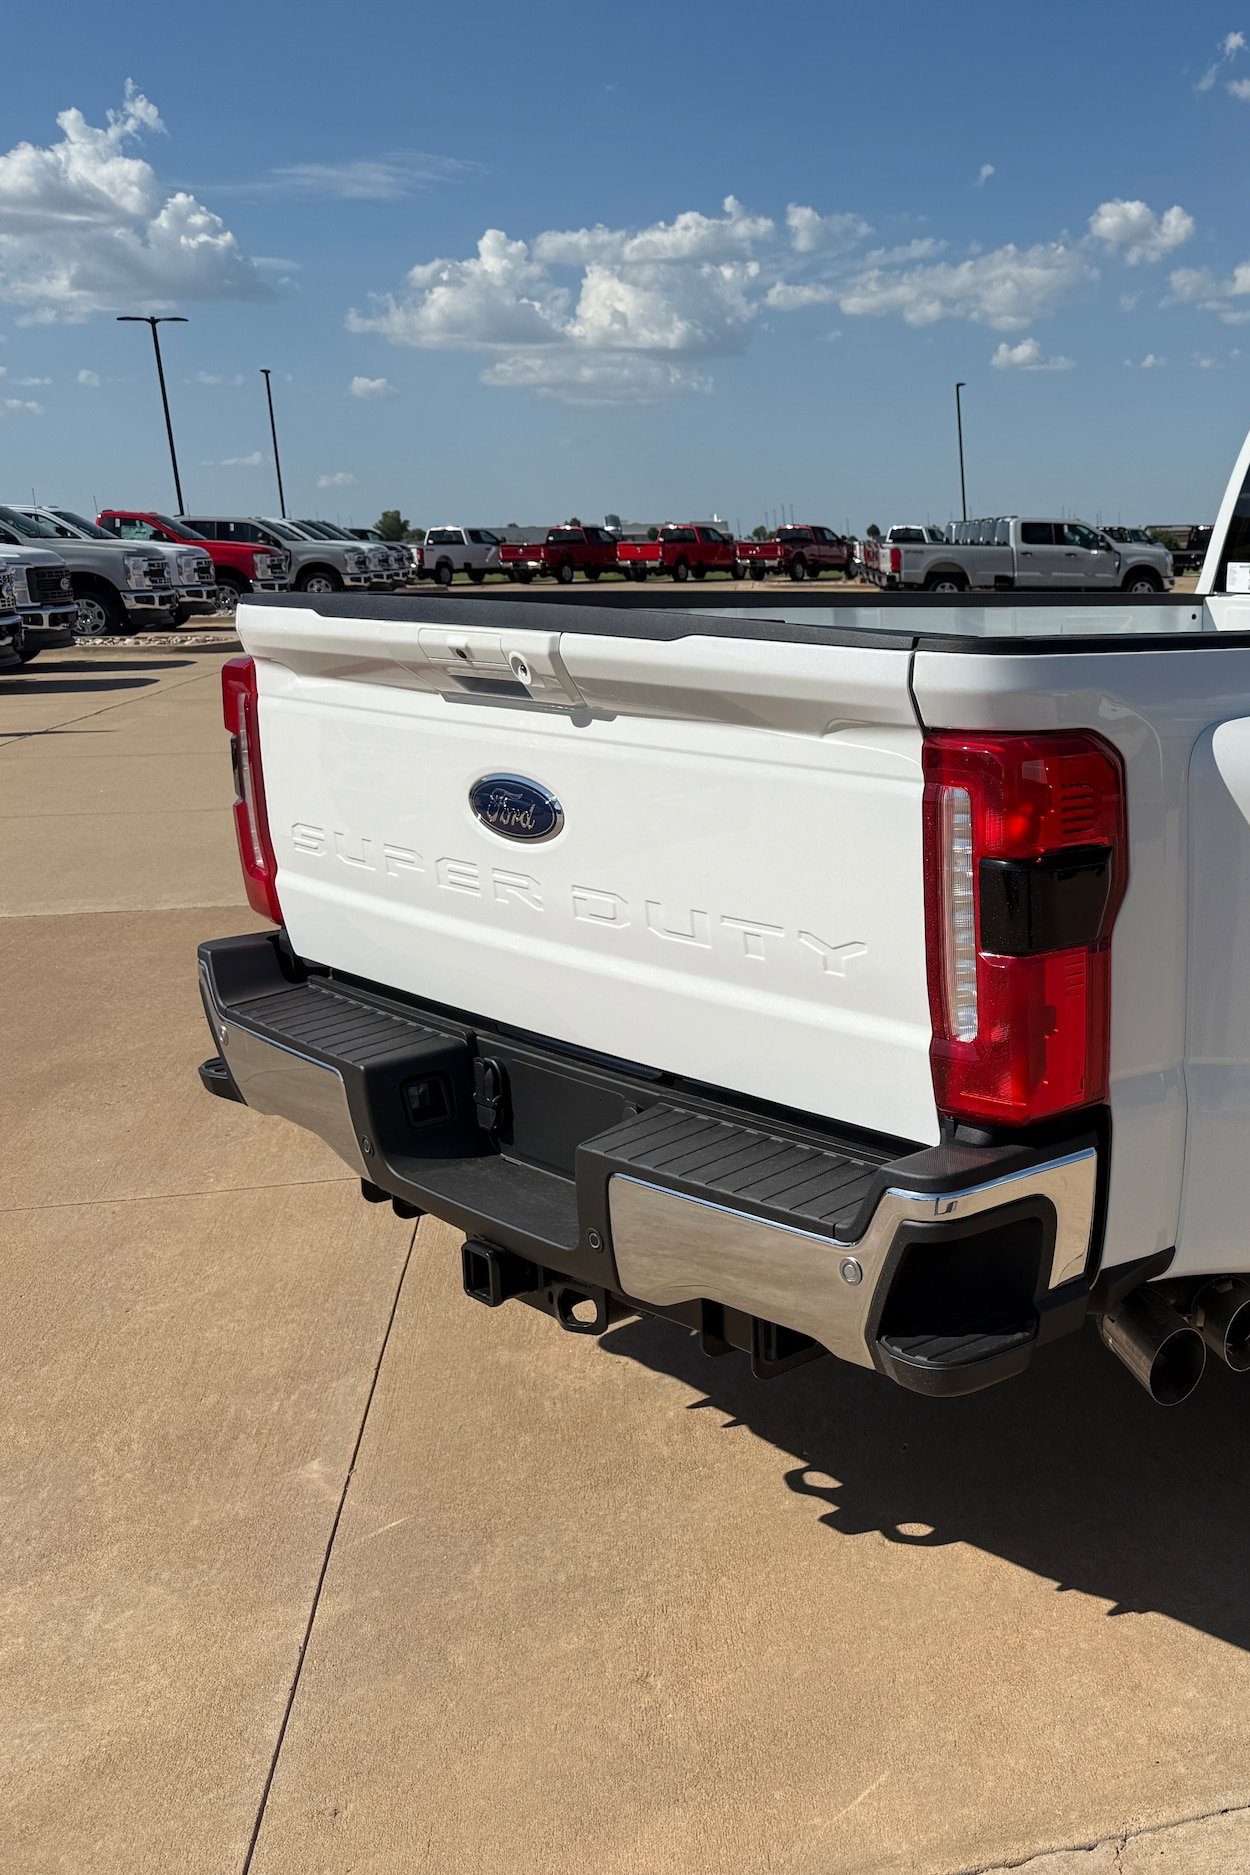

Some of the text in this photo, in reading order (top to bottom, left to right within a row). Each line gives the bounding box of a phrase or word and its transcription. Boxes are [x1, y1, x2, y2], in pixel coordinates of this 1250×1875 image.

[486, 787, 536, 830] Ford
[291, 822, 868, 977] SUPER DUTY
